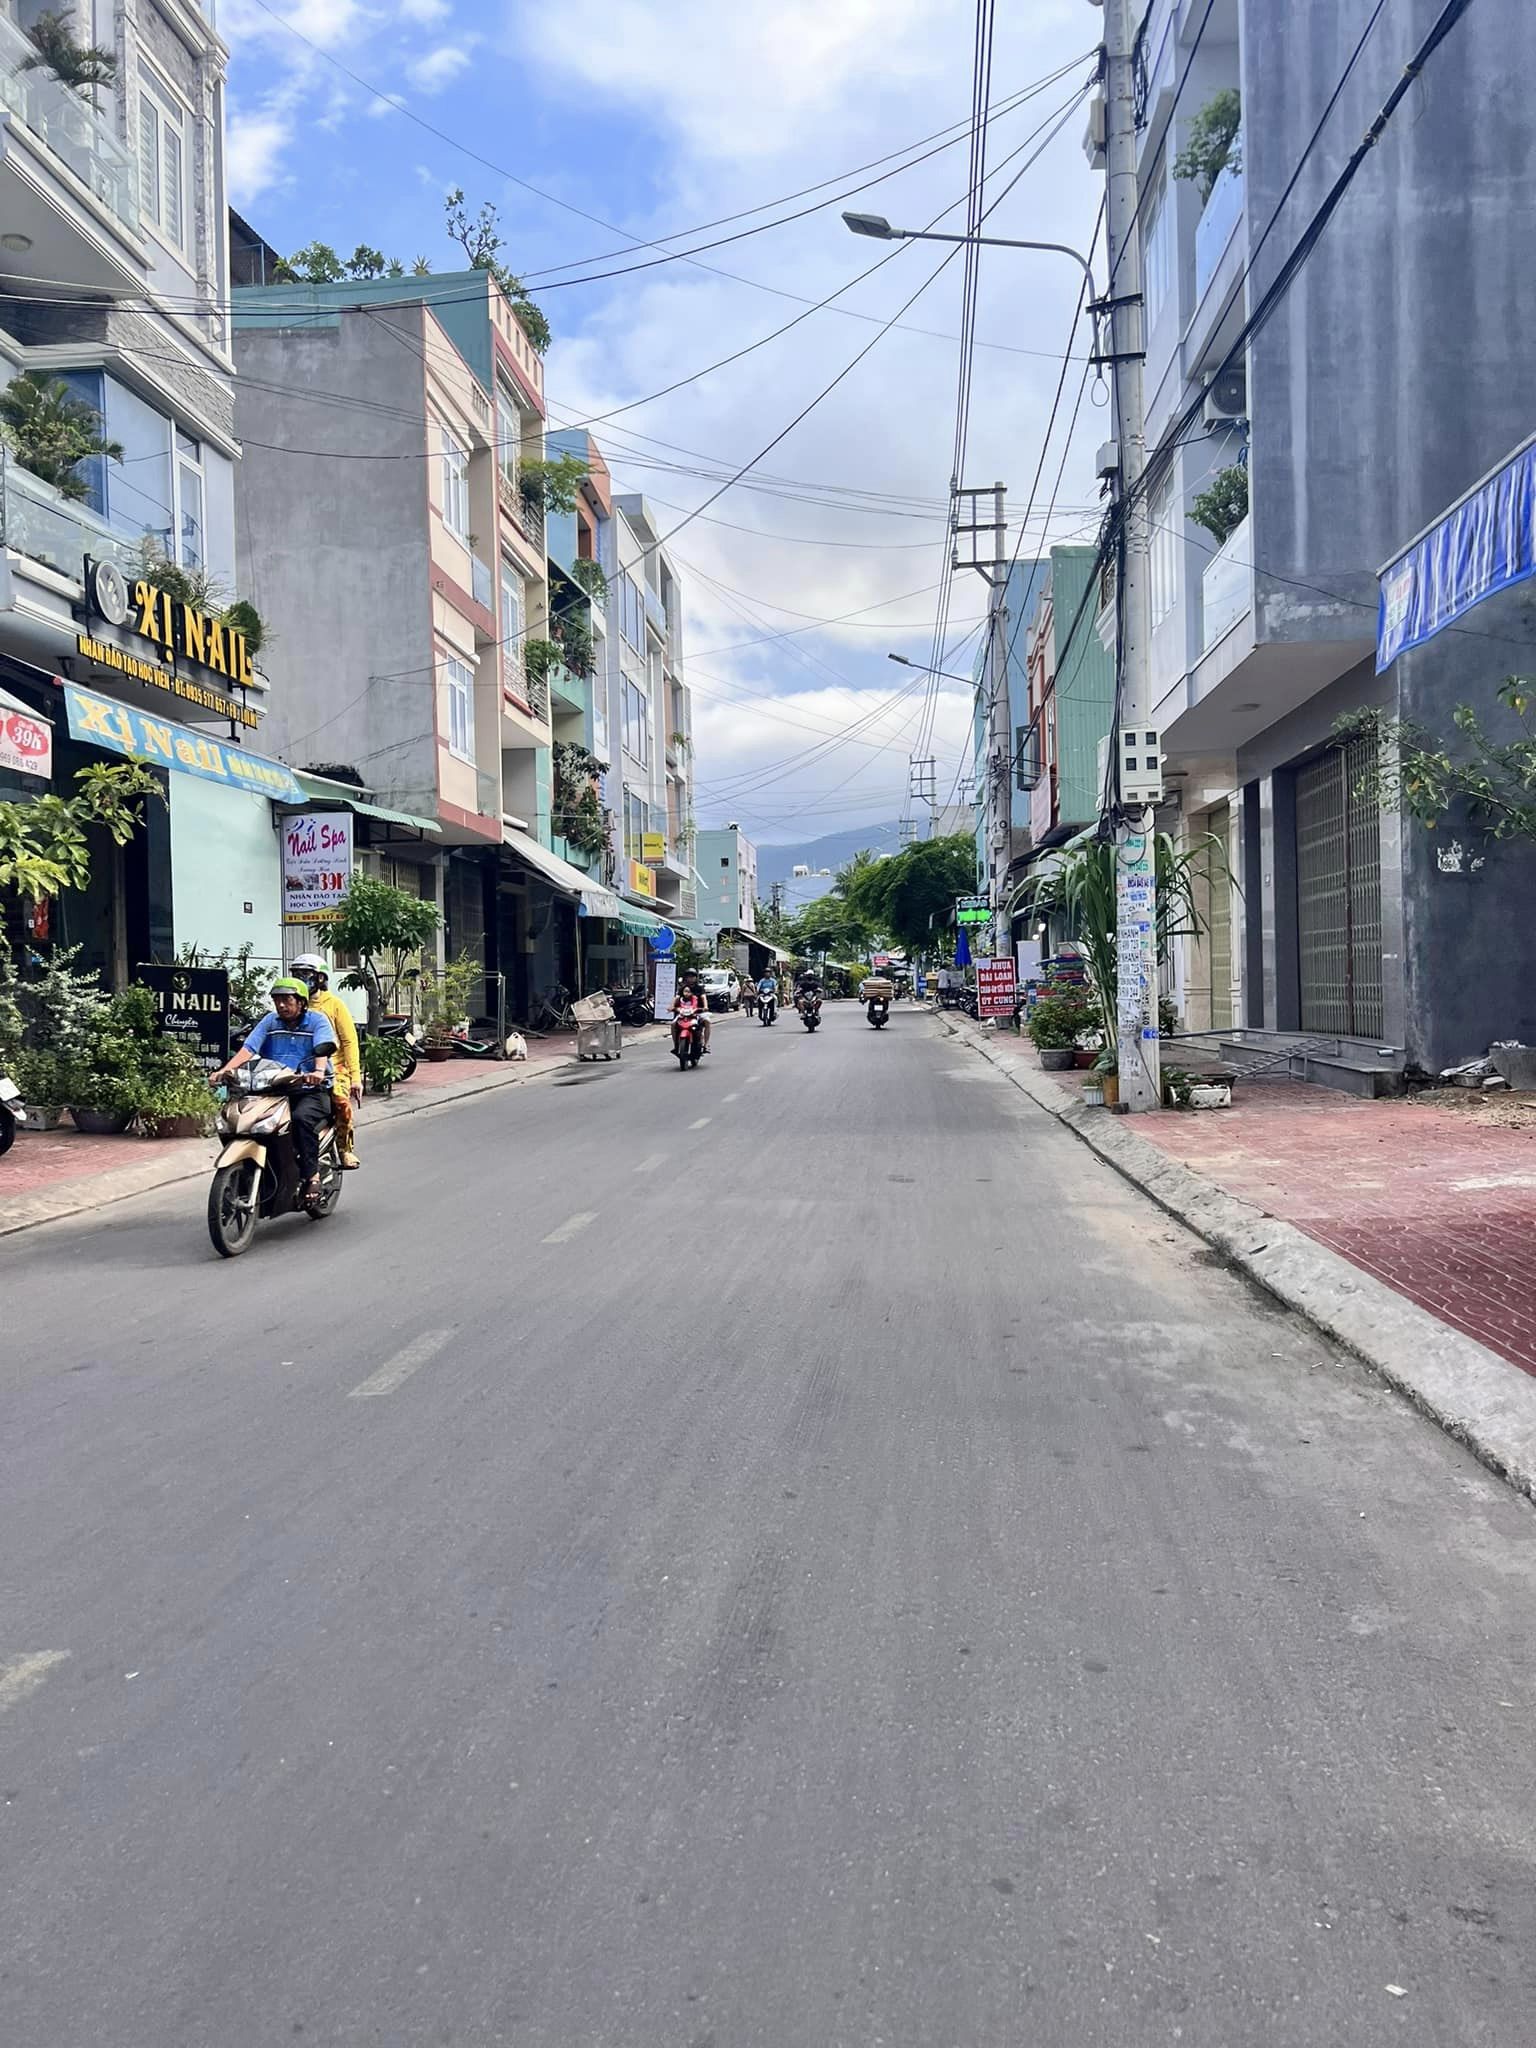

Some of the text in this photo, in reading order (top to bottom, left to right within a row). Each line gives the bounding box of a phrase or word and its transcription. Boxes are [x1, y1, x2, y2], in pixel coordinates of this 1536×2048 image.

[135, 580, 254, 687] XỊ NAIL
[12, 726, 43, 751] 39K
[72, 692, 137, 752] Xị
[140, 718, 227, 776] Nail
[287, 824, 346, 857] Nail Spa
[320, 872, 346, 891] 39K
[172, 992, 221, 1012] NAIL
